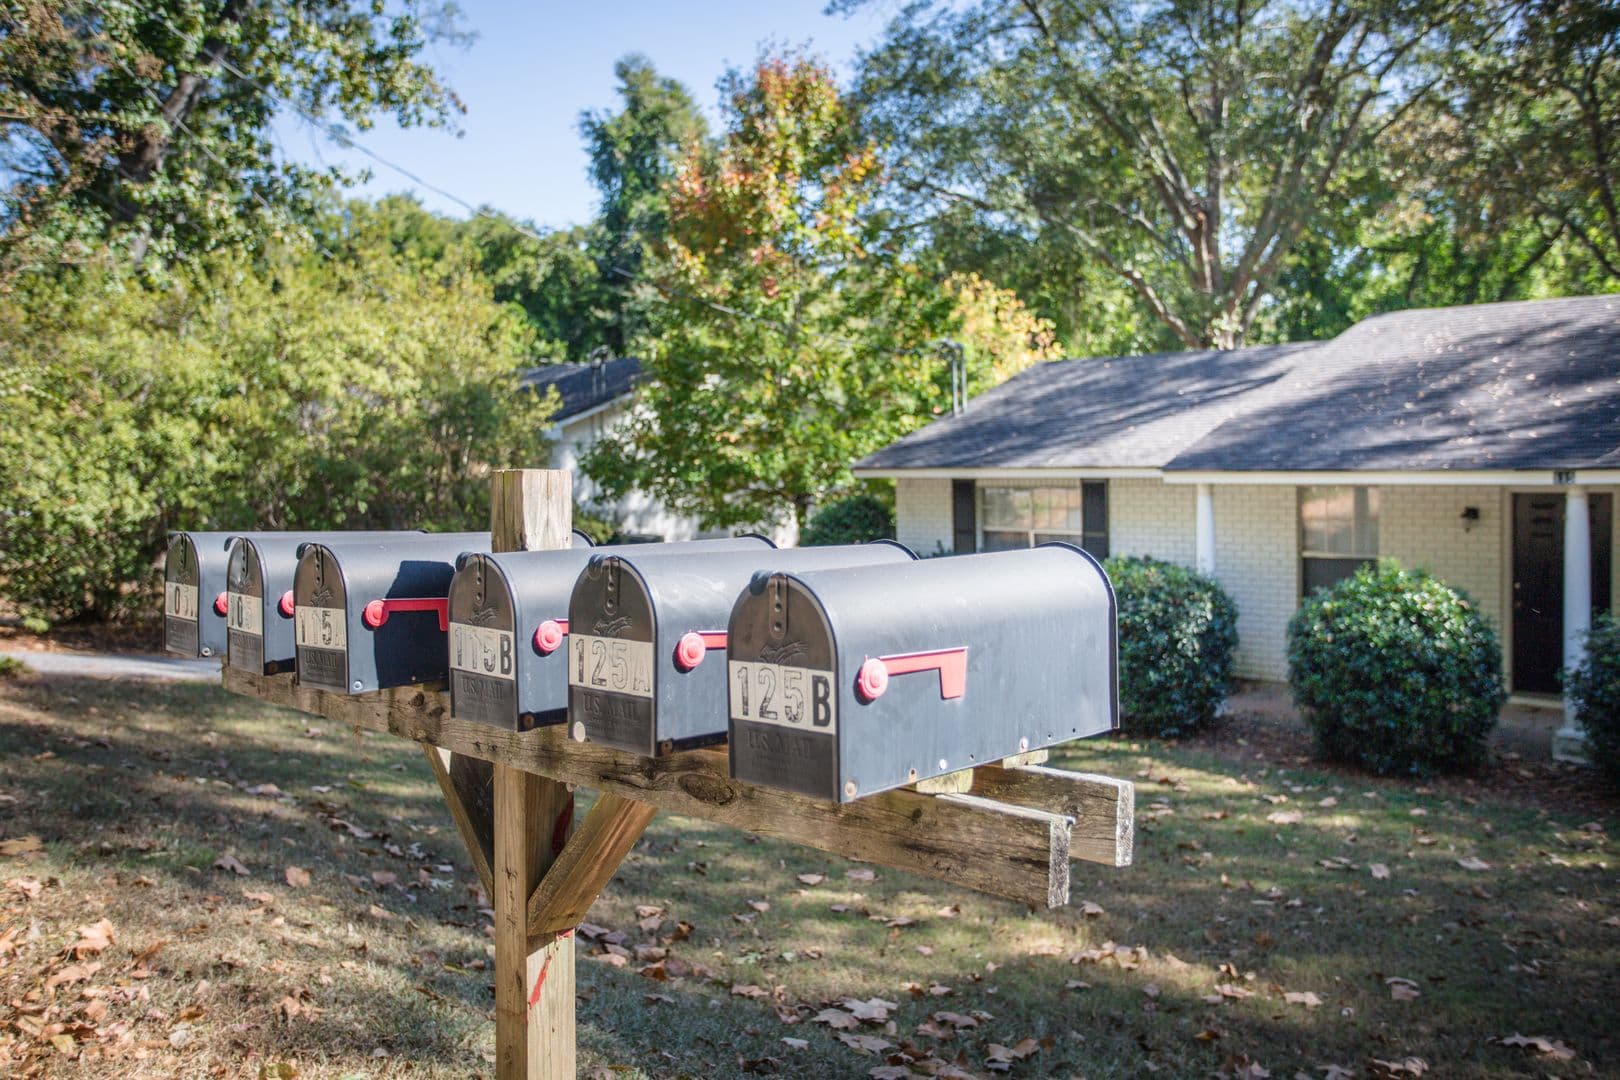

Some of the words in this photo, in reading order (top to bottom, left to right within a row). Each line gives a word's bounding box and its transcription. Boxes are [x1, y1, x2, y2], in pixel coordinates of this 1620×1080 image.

[455, 626, 512, 675] 115B
[576, 638, 651, 692] 125A
[737, 666, 831, 728] 125B
